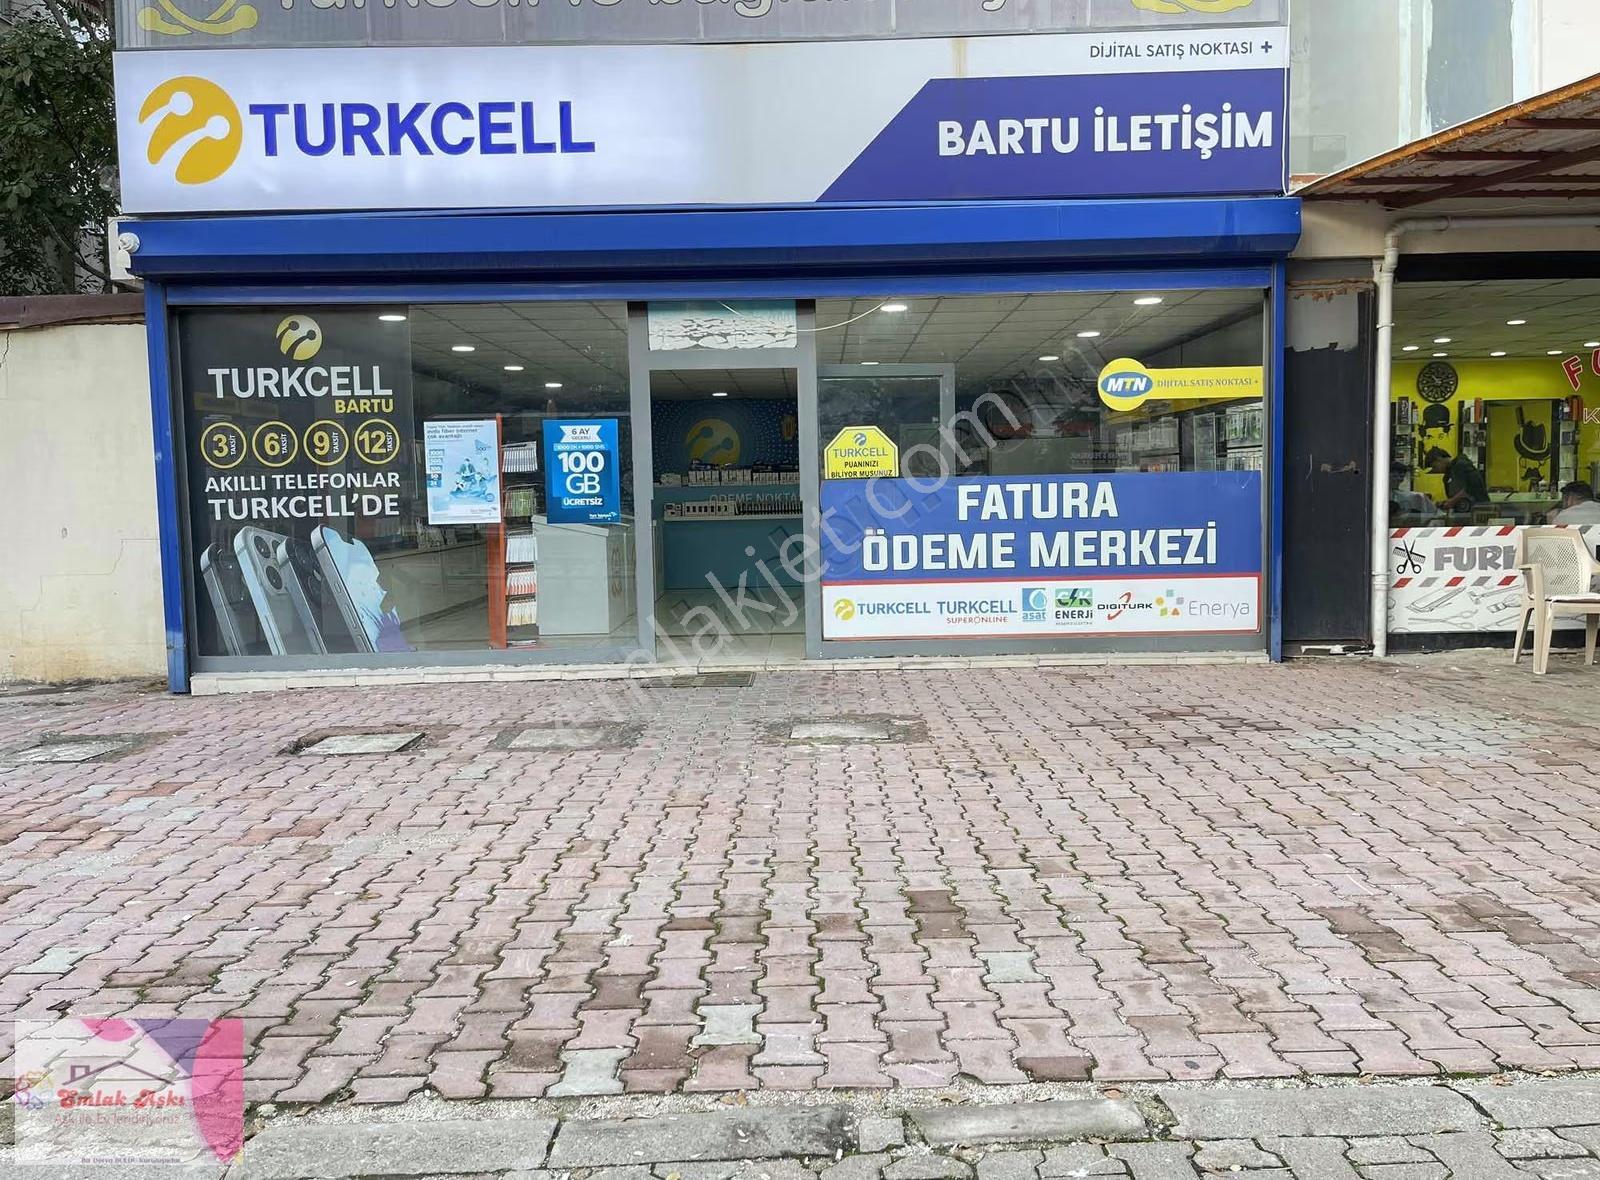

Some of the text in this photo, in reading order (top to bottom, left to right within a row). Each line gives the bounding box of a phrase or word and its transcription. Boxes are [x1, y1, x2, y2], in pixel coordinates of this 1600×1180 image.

[1089, 42, 1142, 58] DİJİTAL
[1146, 43, 1185, 60] SATIŞ
[1189, 41, 1253, 57] NOKTASI
[248, 100, 596, 157] TURKCELL
[938, 102, 1273, 160] BARTU İLETİŞİM
[207, 365, 393, 399] TURKCELL
[1106, 376, 1148, 393] MTN
[335, 398, 394, 414] BARTU
[579, 427, 590, 435] AY
[212, 434, 229, 458] 3
[264, 432, 280, 456] 6
[313, 430, 330, 456] 9
[358, 430, 387, 454] 12
[833, 447, 888, 458] TURKCELL
[558, 451, 605, 473] 100
[205, 472, 400, 493] AKILLI TELEFONLAR
[565, 473, 601, 494] GB
[207, 494, 400, 521] TURKCELL'DE
[563, 496, 603, 506] ÜCRETSİZ
[957, 481, 1119, 521] FATURA
[862, 521, 1217, 571] ÖDEME MERKEZİ
[857, 602, 931, 615] TURKCELL
[937, 600, 1017, 615] TURKCELL
[1022, 611, 1046, 621] asat
[1097, 602, 1153, 610] DIGITURK
[1188, 601, 1250, 620] Enerya
[946, 616, 1009, 625] SUPERONLINE
